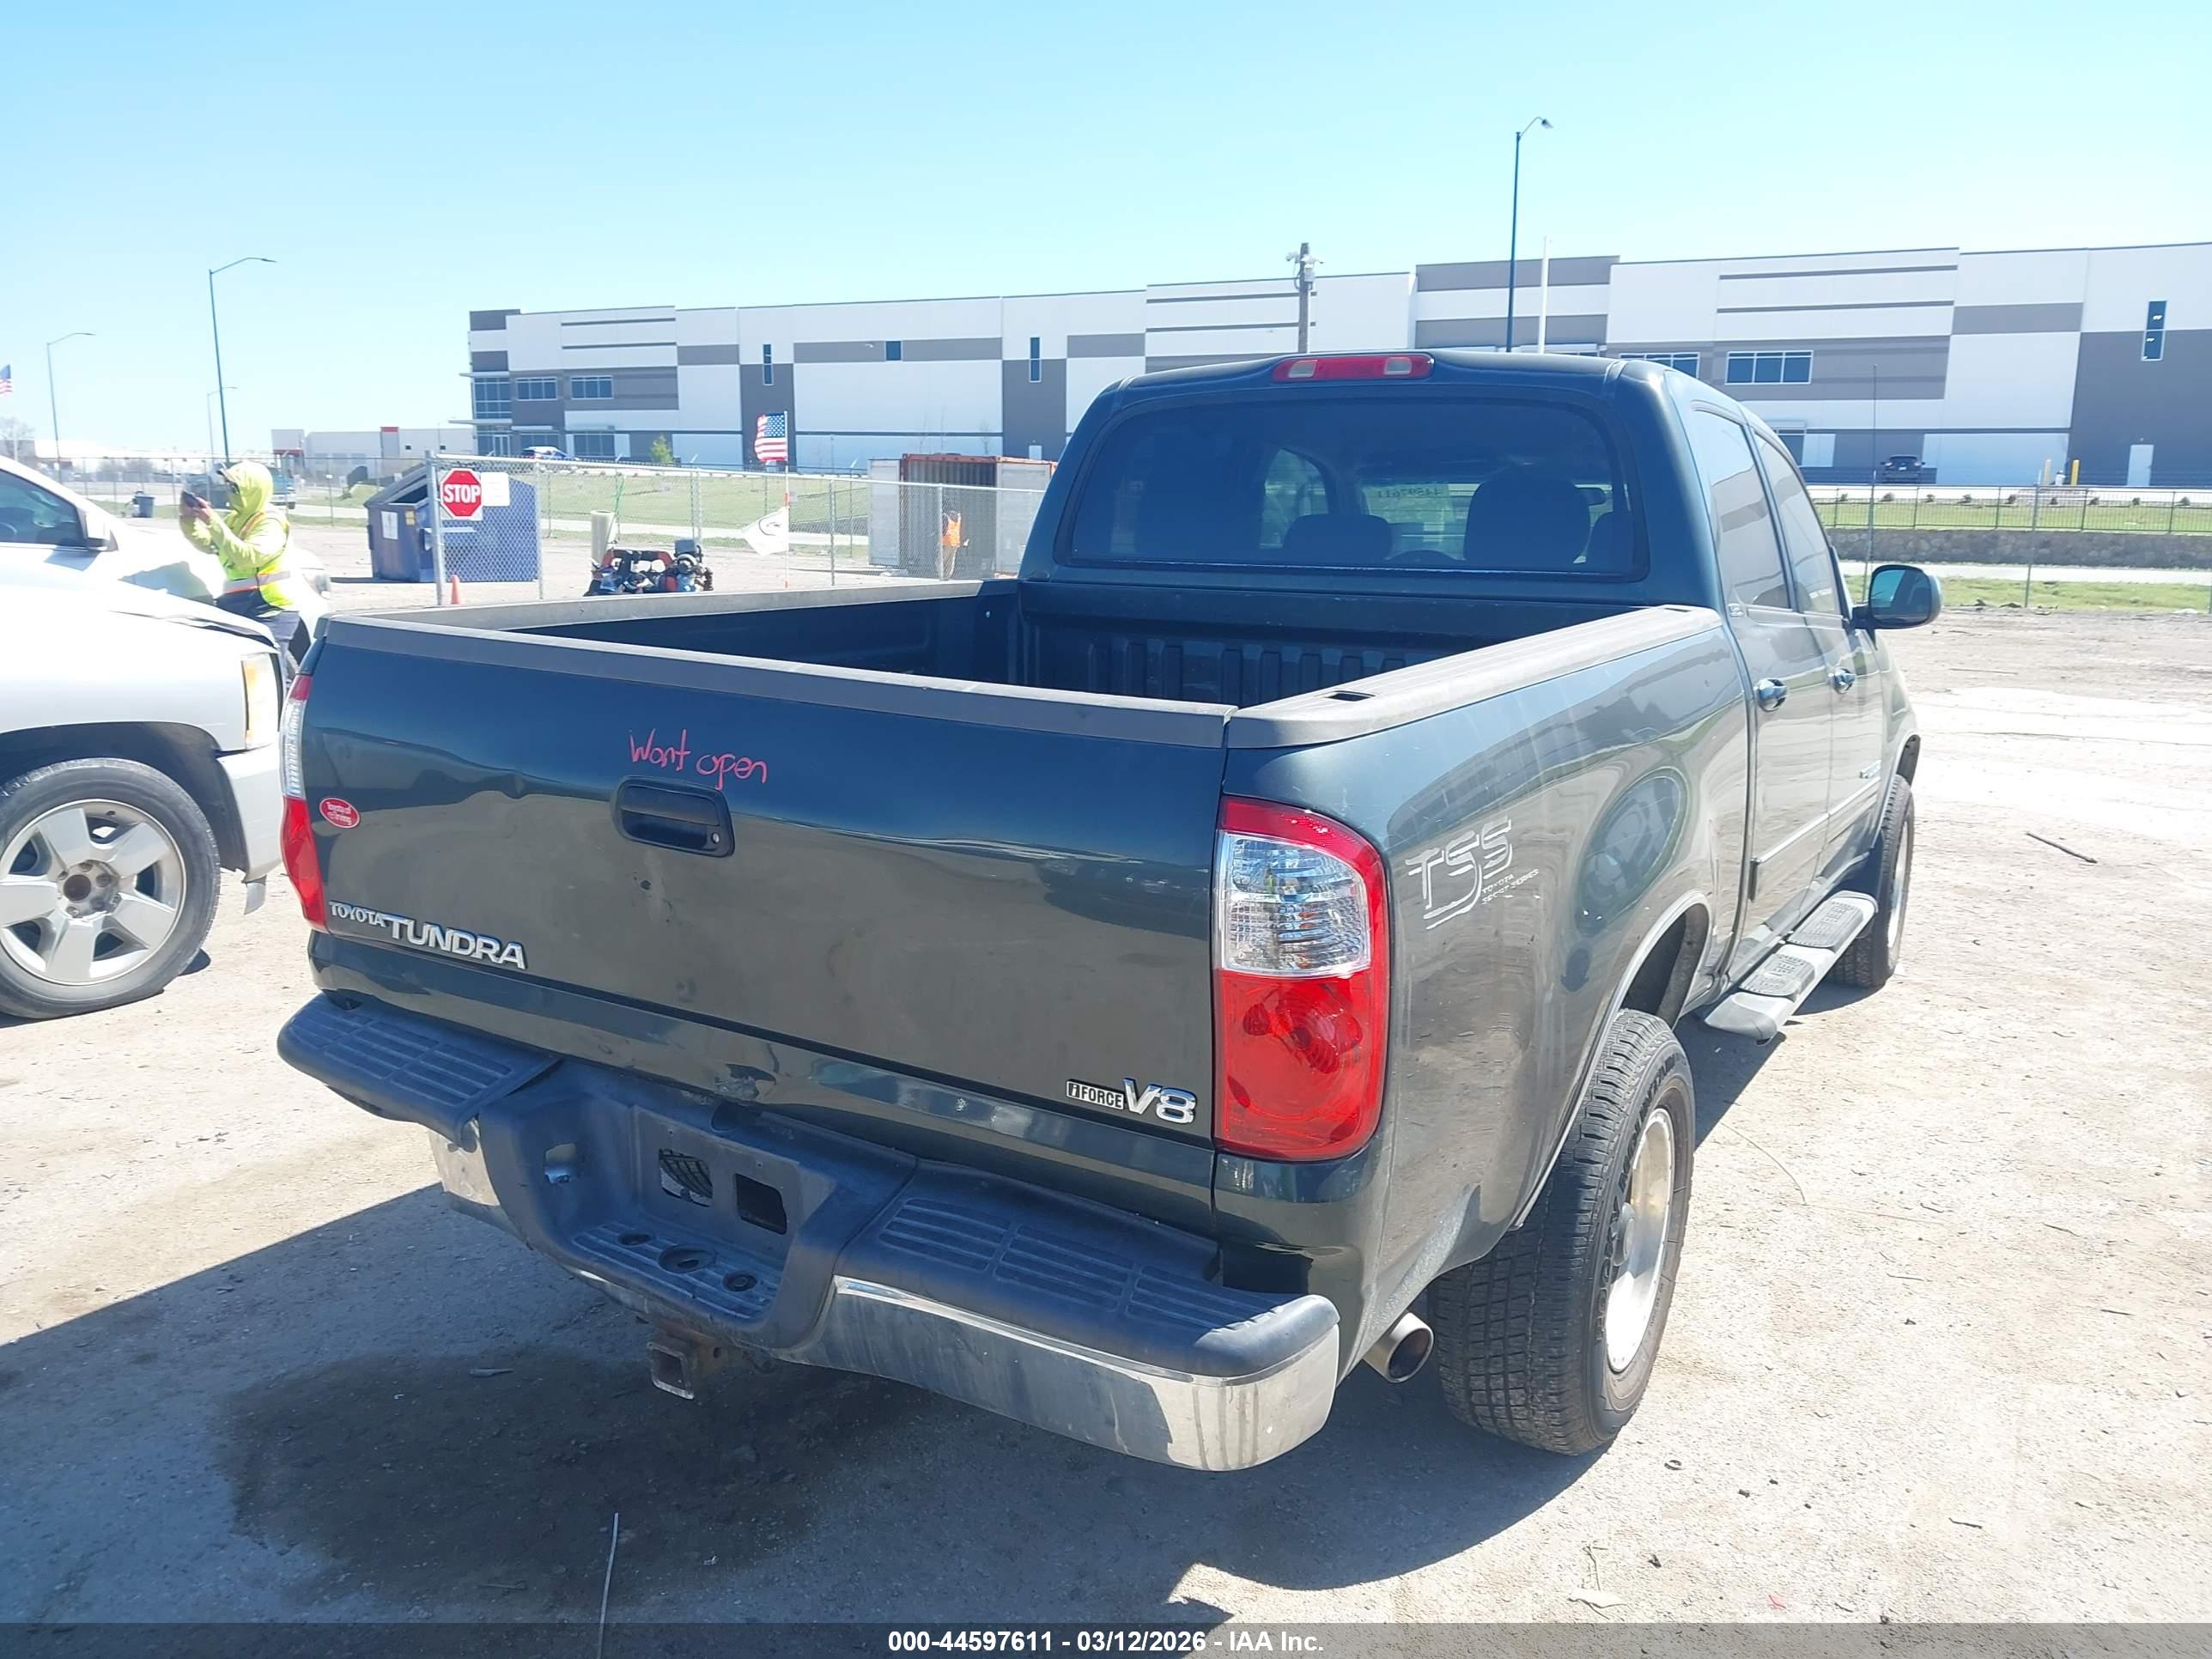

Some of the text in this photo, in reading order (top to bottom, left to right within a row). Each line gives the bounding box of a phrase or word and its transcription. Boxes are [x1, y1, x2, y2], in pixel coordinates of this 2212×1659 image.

[443, 483, 482, 504] STOP
[696, 753, 767, 790] open
[329, 902, 526, 969] TOYOTA TUNDRA
[1122, 1078, 1196, 1124] V8
